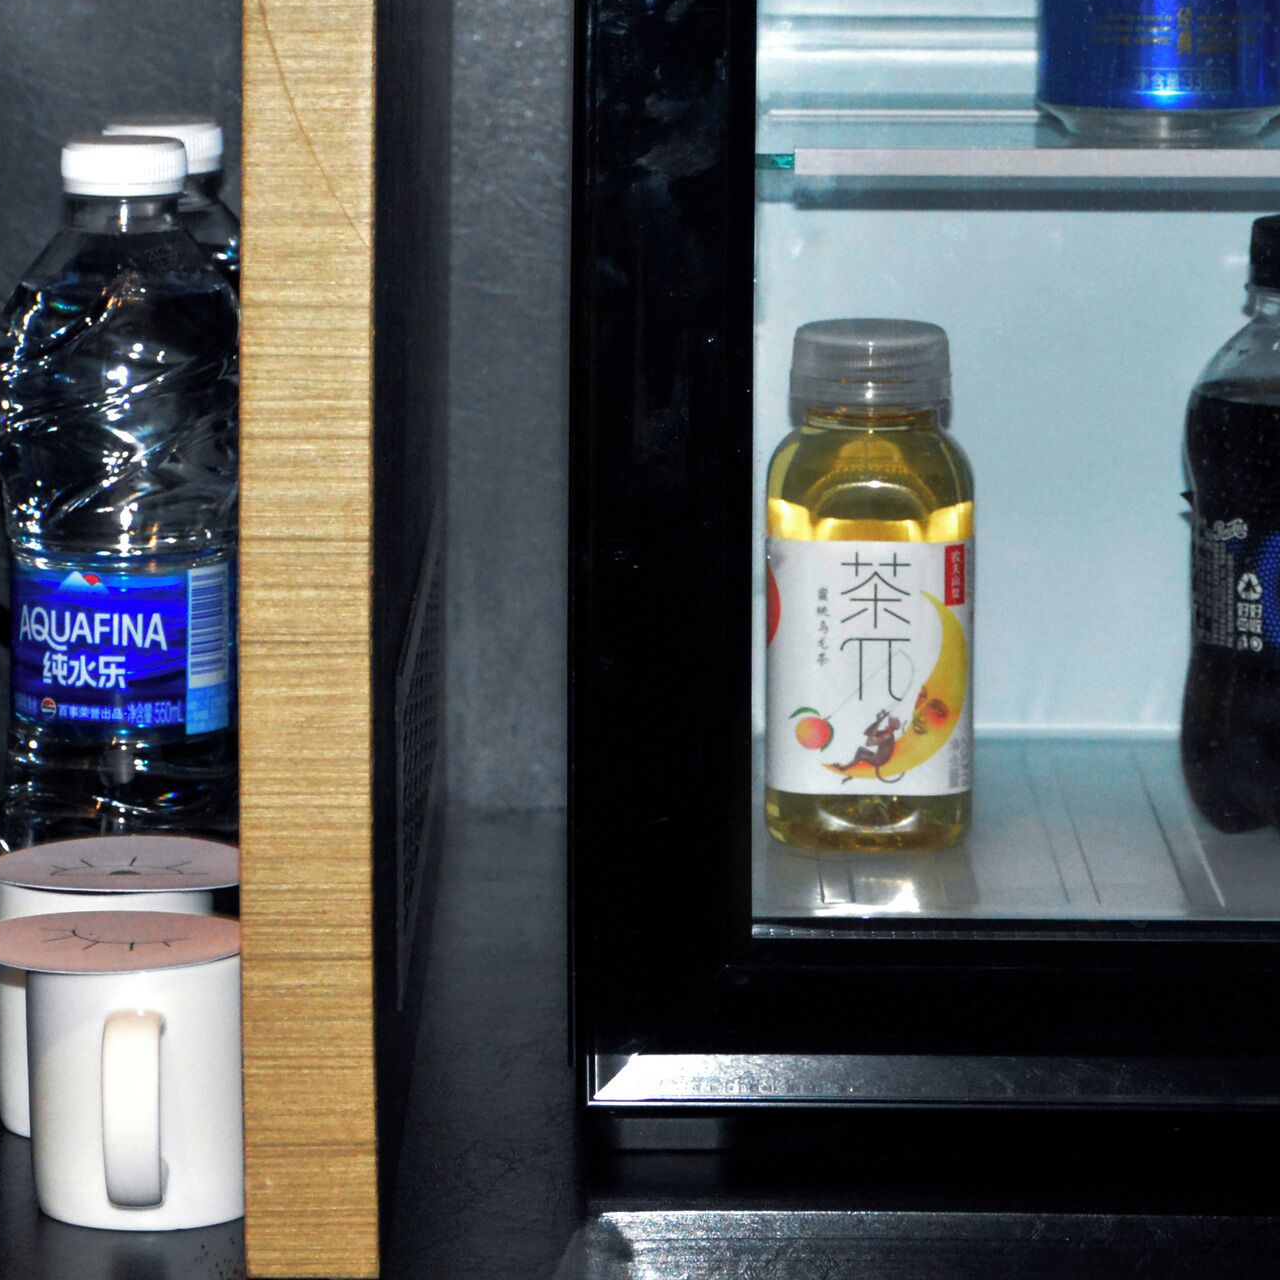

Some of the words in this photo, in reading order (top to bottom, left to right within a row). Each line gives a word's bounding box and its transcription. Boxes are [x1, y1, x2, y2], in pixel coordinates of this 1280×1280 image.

[19, 604, 168, 652] AQUAFINA
[42, 651, 127, 689] 纯水乐
